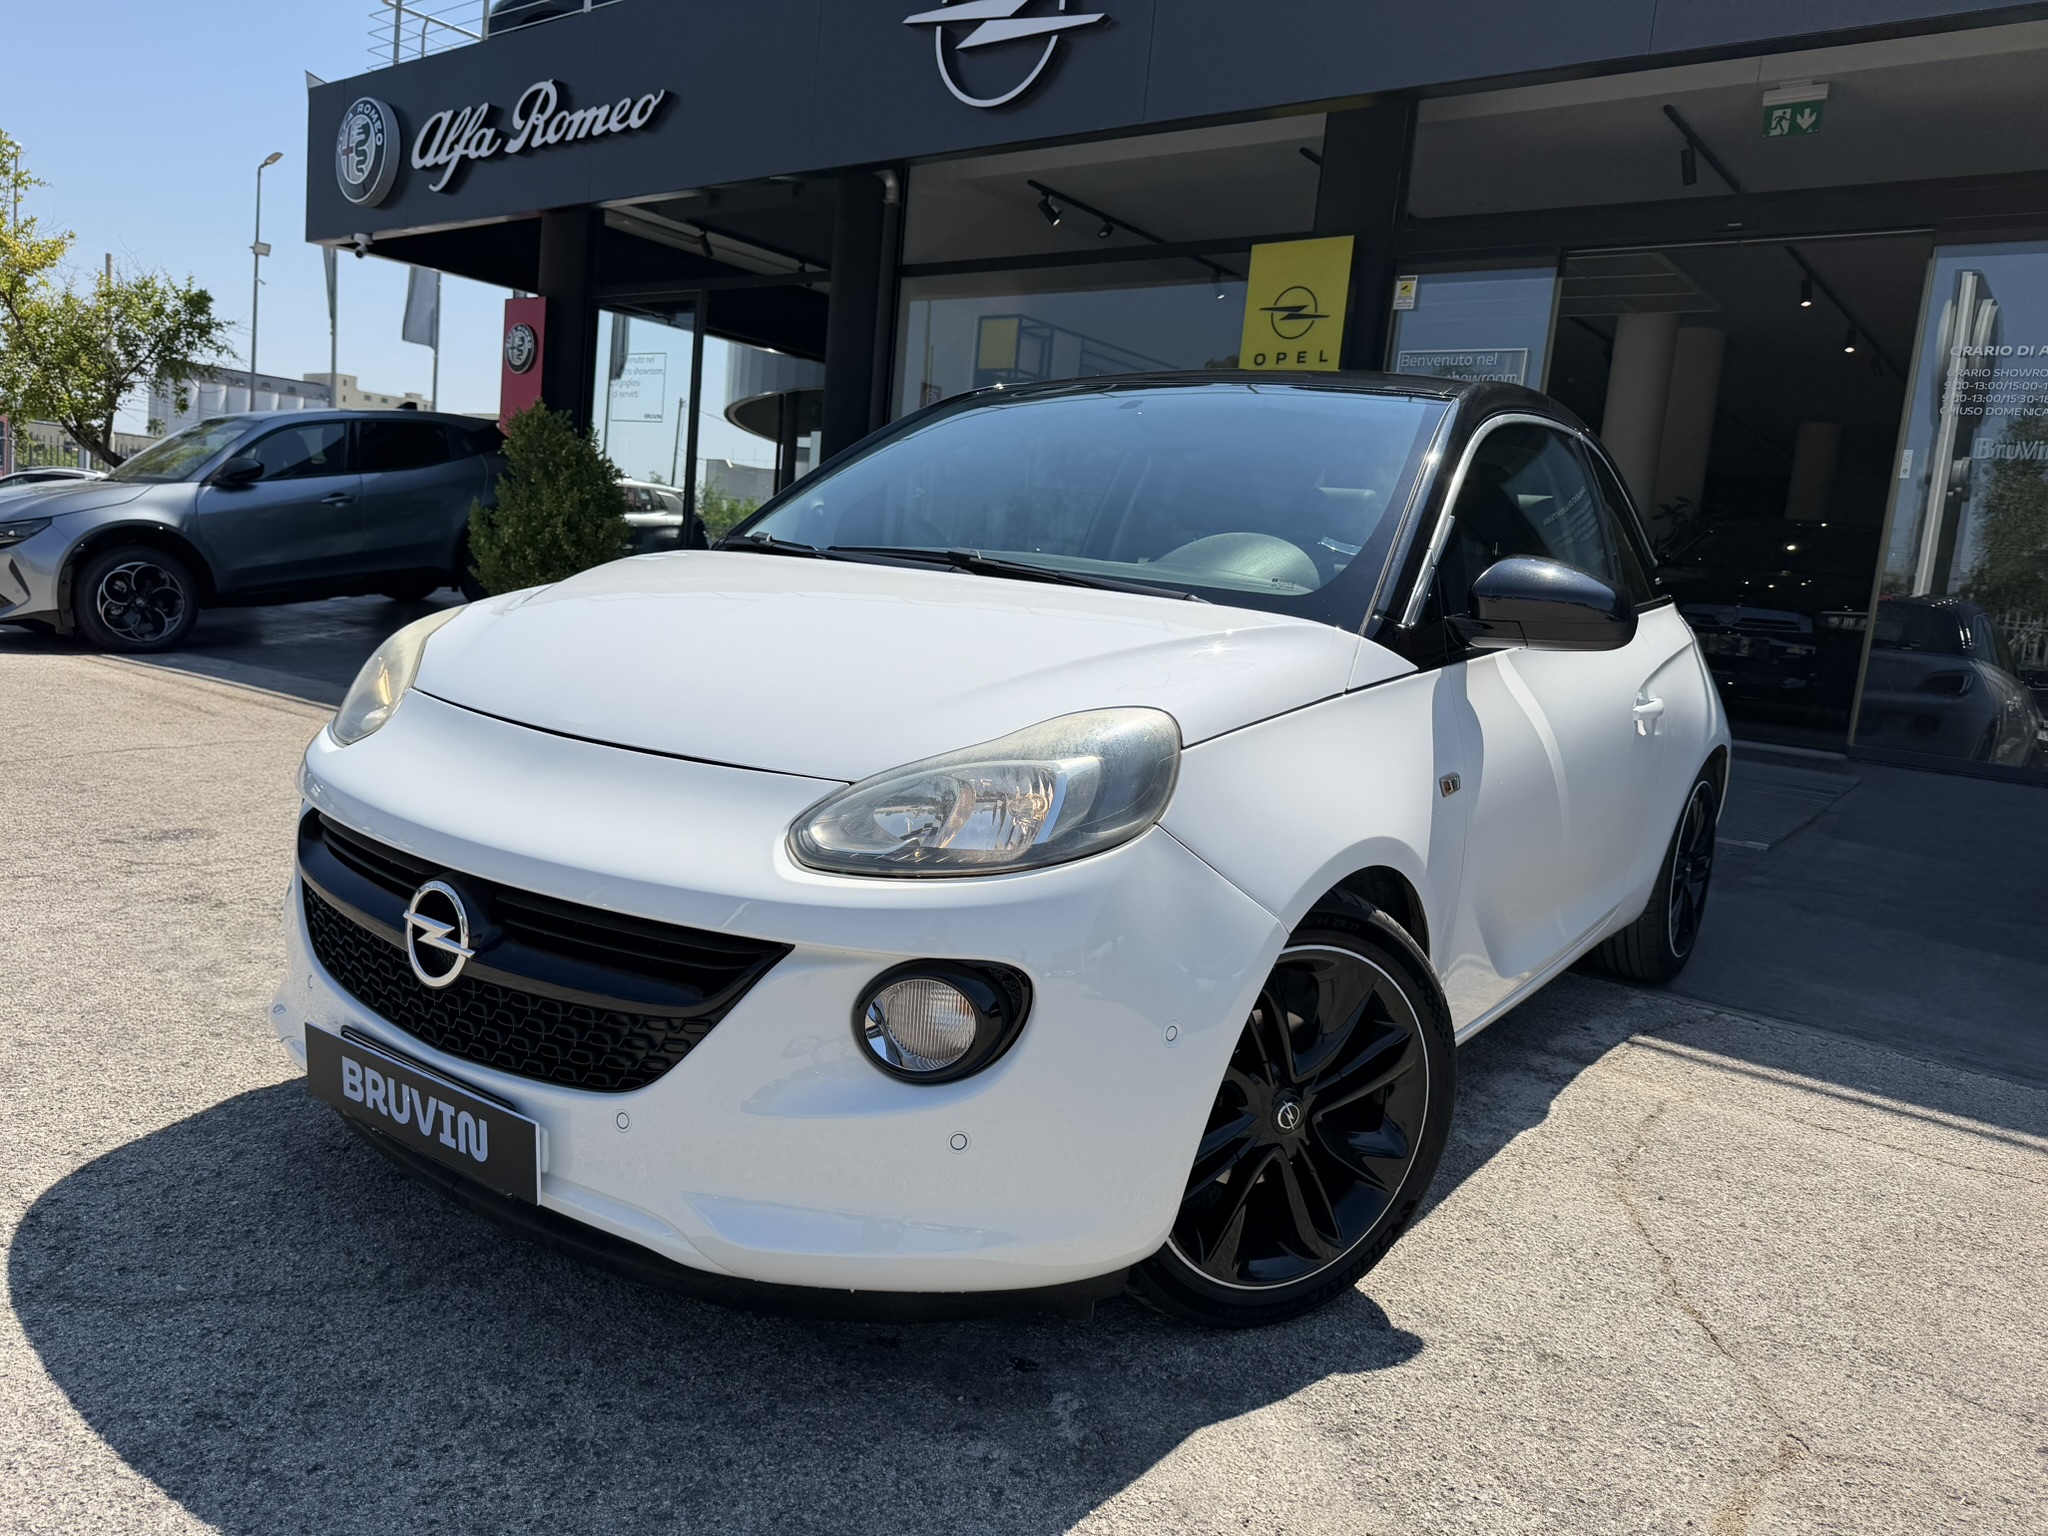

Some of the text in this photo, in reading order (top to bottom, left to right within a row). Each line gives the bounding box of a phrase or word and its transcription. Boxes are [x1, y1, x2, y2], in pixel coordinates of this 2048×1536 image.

[357, 103, 383, 146] ROMEO
[411, 102, 502, 192] Alfa
[505, 79, 665, 154] Romeo
[1254, 349, 1329, 366] OPEL
[1950, 345, 2013, 356] ORARIO
[2017, 345, 2035, 356] DI
[1400, 352, 1498, 367] Benvenuto nel
[1947, 369, 1991, 378] ORARIO
[1944, 381, 2048, 390] 900-13:00/15:00-1
[1942, 394, 2048, 403] 900-13:00/15:30-18
[341, 1055, 488, 1163] BRUVIN
